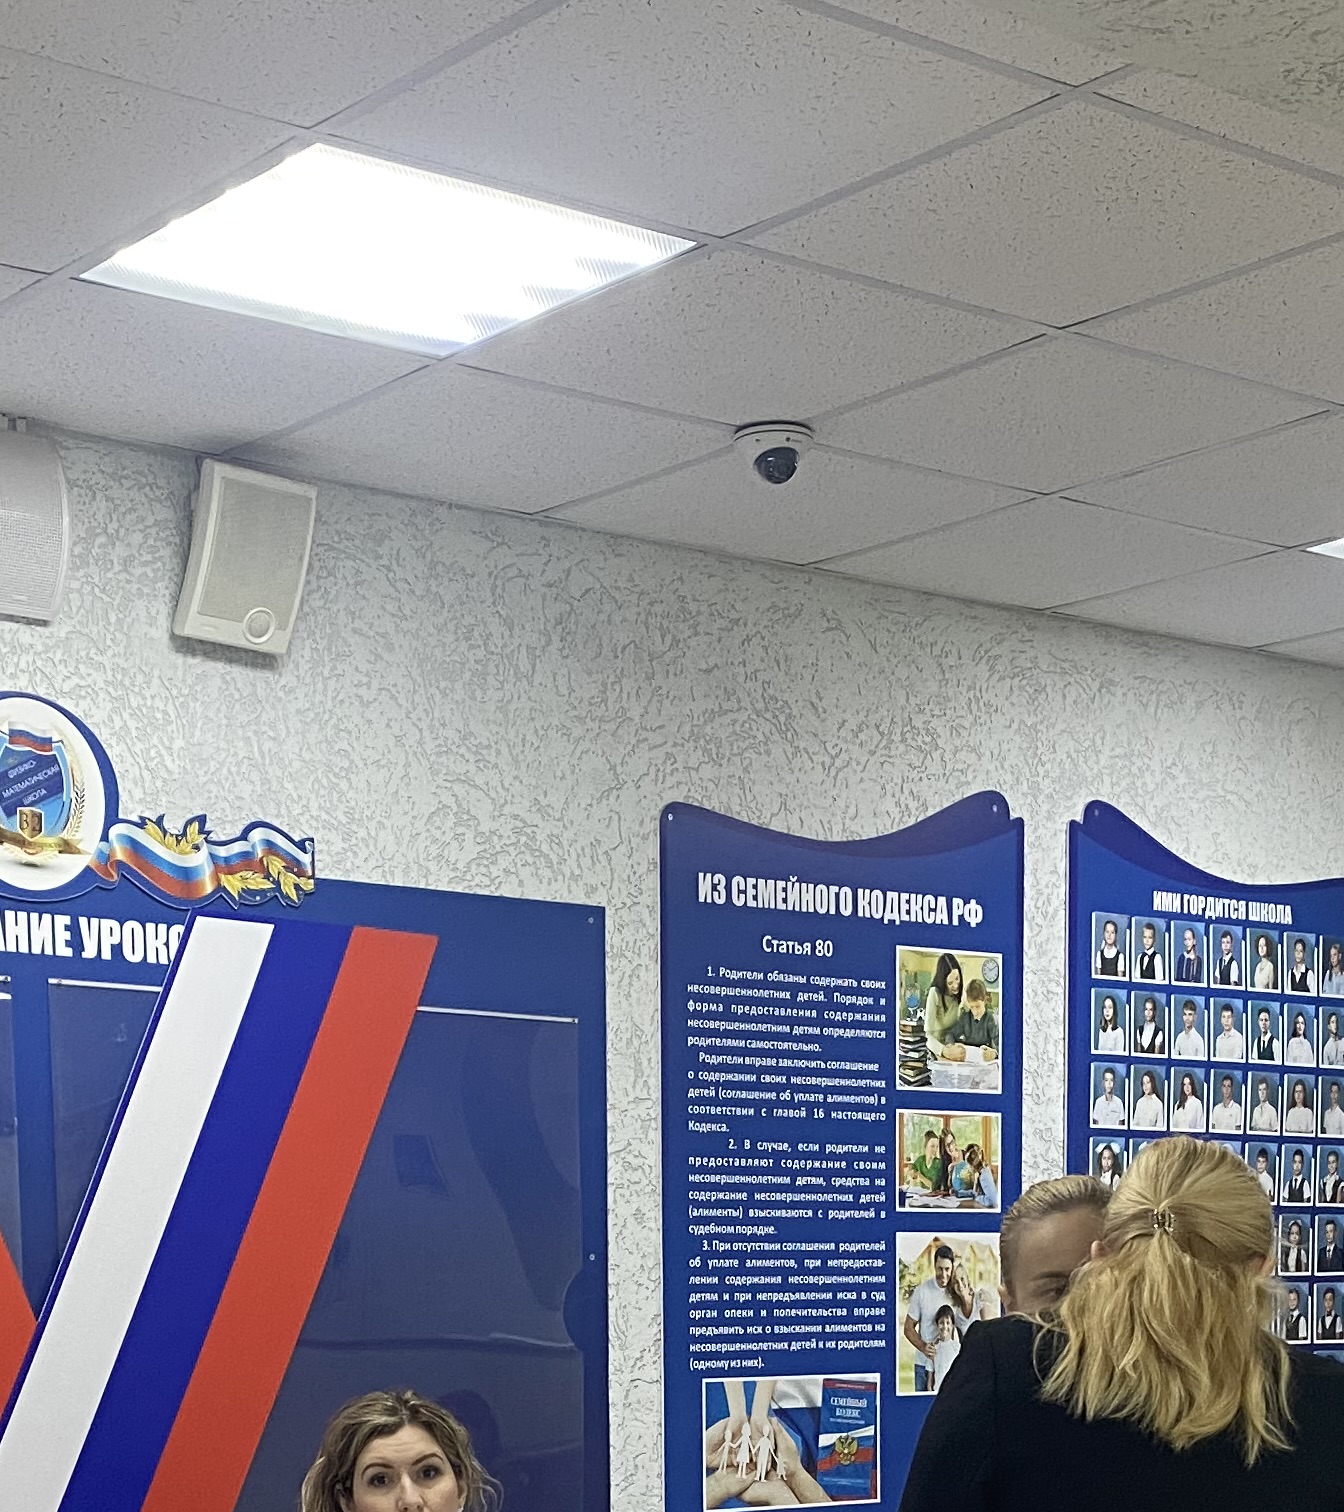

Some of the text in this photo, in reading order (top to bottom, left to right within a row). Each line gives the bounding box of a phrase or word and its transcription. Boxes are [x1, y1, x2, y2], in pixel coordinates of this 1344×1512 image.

[698, 872, 983, 928] ИЗ СЕМЕЙНОГО КОДЕКСА РФ
[1153, 890, 1292, 925] ИМИ ГОРДИТСЯ ШКОЛА
[762, 935, 833, 958] Статья 80
[719, 966, 764, 980] Родители
[766, 970, 806, 984] обязаны
[809, 975, 858, 988] содержать
[860, 979, 886, 990] своих
[686, 984, 886, 1006] несовершеннолетних детей. Порядок и
[686, 999, 886, 1023] форма предоставления содержания
[687, 1019, 886, 1038] несовершеннолетним детям определяются
[687, 1036, 822, 1052] родителями самостоятельно.
[698, 1051, 879, 1071] Родители вправе заключить соглашение
[687, 1071, 886, 1088] о содержании своих несовершеннолетних
[687, 1086, 886, 1106] детей (соглашение об уплате алиментов) в
[687, 1105, 886, 1122] соответствии с главой 16 настоящего
[688, 1119, 730, 1133] Кодекса.
[743, 1138, 751, 1150] В
[756, 1141, 791, 1153] случае,
[797, 1142, 819, 1152] если
[825, 1143, 869, 1155] родители
[874, 1144, 886, 1154] не
[688, 1157, 886, 1171] предоставляют содержание своим
[688, 1174, 886, 1187] несовершеннолетним детям, средства на
[688, 1190, 886, 1204] содержание несовершеннолетних детей
[688, 1205, 886, 1221] (алименты) взыскиваются с родителей в
[688, 1222, 777, 1237] судебном порядке.
[712, 1239, 731, 1253] При
[732, 1242, 781, 1253] отсутствии
[781, 1242, 835, 1251] соглашения
[838, 1240, 886, 1253] родителей
[688, 1256, 886, 1270] об уплате алиментов, при непредостав-
[688, 1274, 886, 1287] лении содержания несовершеннолетним
[688, 1290, 886, 1304] детям и при непредъявлении иска в суд
[688, 1307, 886, 1320] орган опеки и попечительства вправе
[689, 1323, 886, 1337] предъявить иск о взыскании алиментов на
[689, 1338, 886, 1353] несовершеннолетних детей к их родителям
[689, 1356, 765, 1371] (одному из них).
